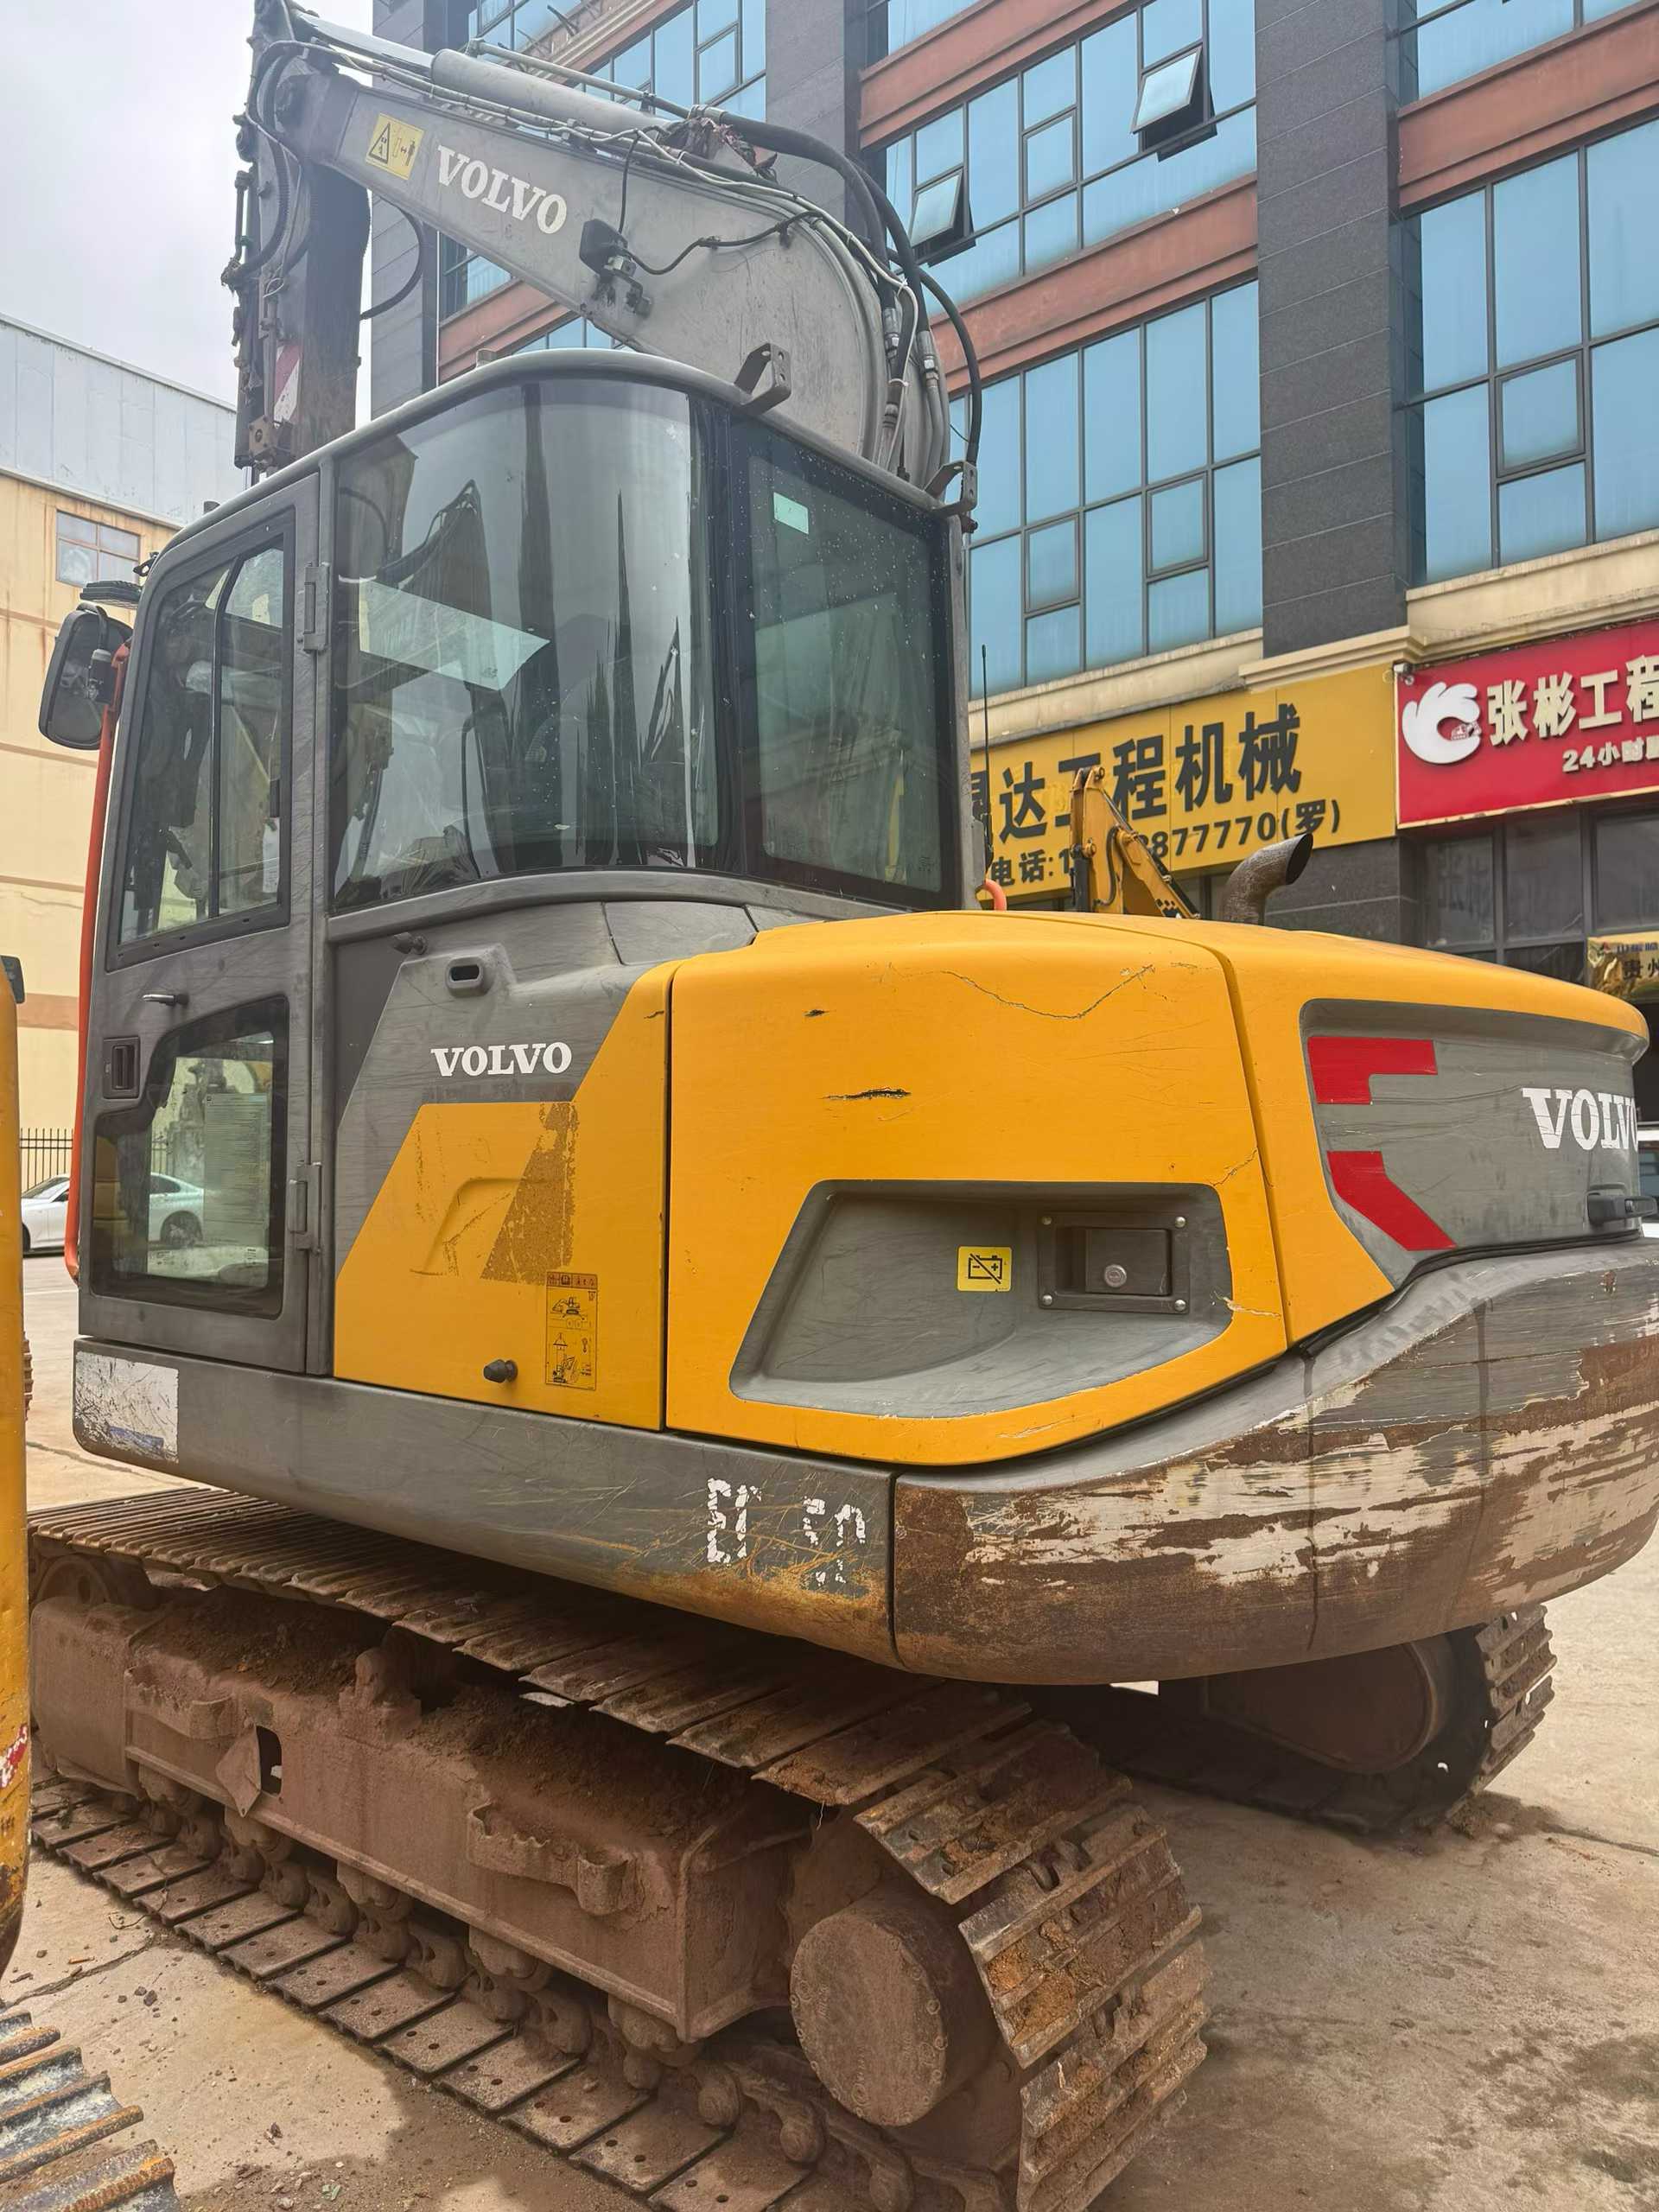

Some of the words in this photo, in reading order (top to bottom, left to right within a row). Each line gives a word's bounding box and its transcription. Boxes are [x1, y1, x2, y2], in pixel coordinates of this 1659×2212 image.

[437, 144, 568, 234] VOLVO
[1486, 654, 1659, 747] 张彬工程
[970, 702, 1302, 844] 达程机械
[430, 1041, 572, 1077] VOLVO
